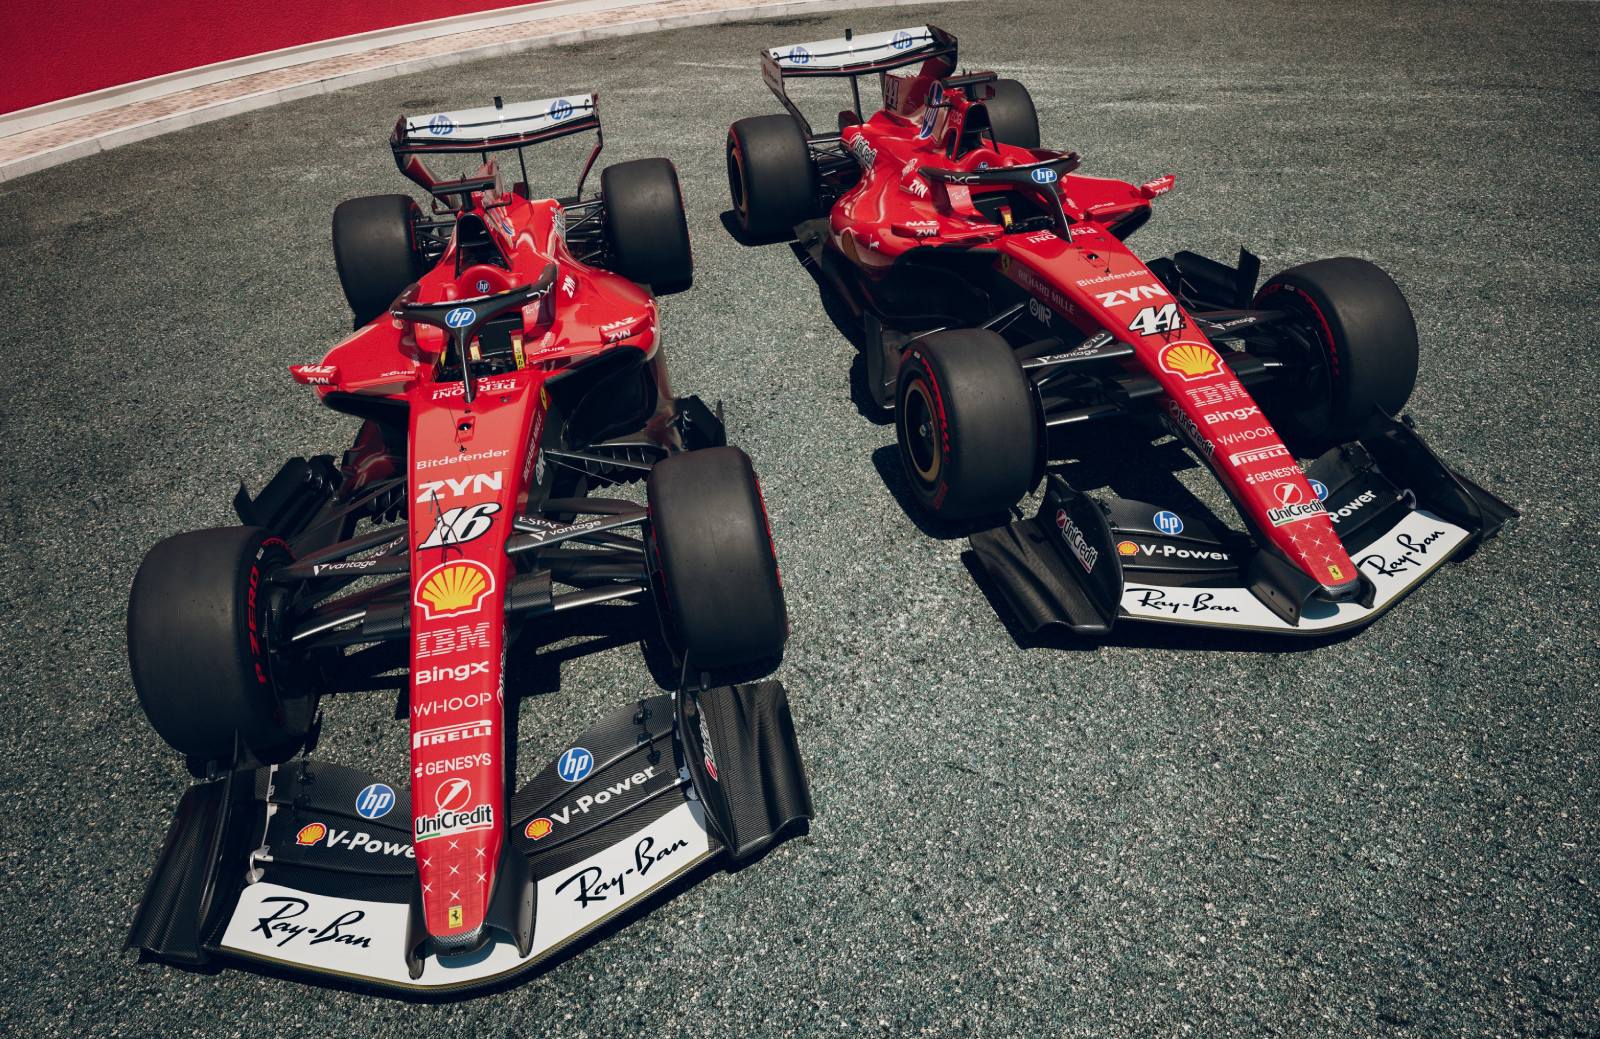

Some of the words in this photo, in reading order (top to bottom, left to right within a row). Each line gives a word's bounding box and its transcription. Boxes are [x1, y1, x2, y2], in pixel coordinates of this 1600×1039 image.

[553, 99, 572, 121] hp
[430, 115, 453, 135] hp
[1035, 169, 1056, 184] hp
[909, 180, 928, 199] ZYN
[478, 281, 490, 294] hp
[562, 274, 576, 298] ZYN
[1076, 269, 1150, 287] Bitdefender
[1095, 283, 1169, 308] ZYN
[449, 307, 473, 328] hp
[1128, 302, 1187, 337] 44
[608, 329, 631, 343] ZYN
[1053, 346, 1099, 361] vantage
[307, 377, 330, 385] ZYN
[1185, 380, 1249, 408] IBM
[1204, 406, 1261, 425] Bingx
[1217, 426, 1275, 446] WHOOP
[416, 448, 510, 470] Bitdefender
[1229, 443, 1290, 468] PIRELLI
[1254, 465, 1306, 483] GENESYS
[416, 471, 502, 503] ZYN
[1268, 500, 1326, 523] UniCredit
[416, 502, 502, 551] 16
[549, 519, 602, 535] vantage
[1157, 512, 1181, 536] hp
[1063, 519, 1099, 567] UniCredit
[1140, 544, 1229, 561] V-Power
[1357, 528, 1445, 578] Ray-Ban
[329, 560, 377, 570] vantage
[1125, 588, 1241, 613] Ray-Ban
[416, 622, 491, 660] IBM
[416, 660, 490, 686] Bingx
[414, 692, 492, 717] WHOOP
[413, 719, 493, 749] PIRELLI
[425, 752, 492, 776] GENESYS
[563, 748, 590, 781] hp
[360, 784, 391, 819] hp
[551, 765, 656, 825] V-Power
[416, 804, 492, 836] UniCredit
[324, 829, 417, 860] V-Powe
[555, 837, 689, 909] Ray-Ban
[250, 896, 372, 948] Ray-Ban
